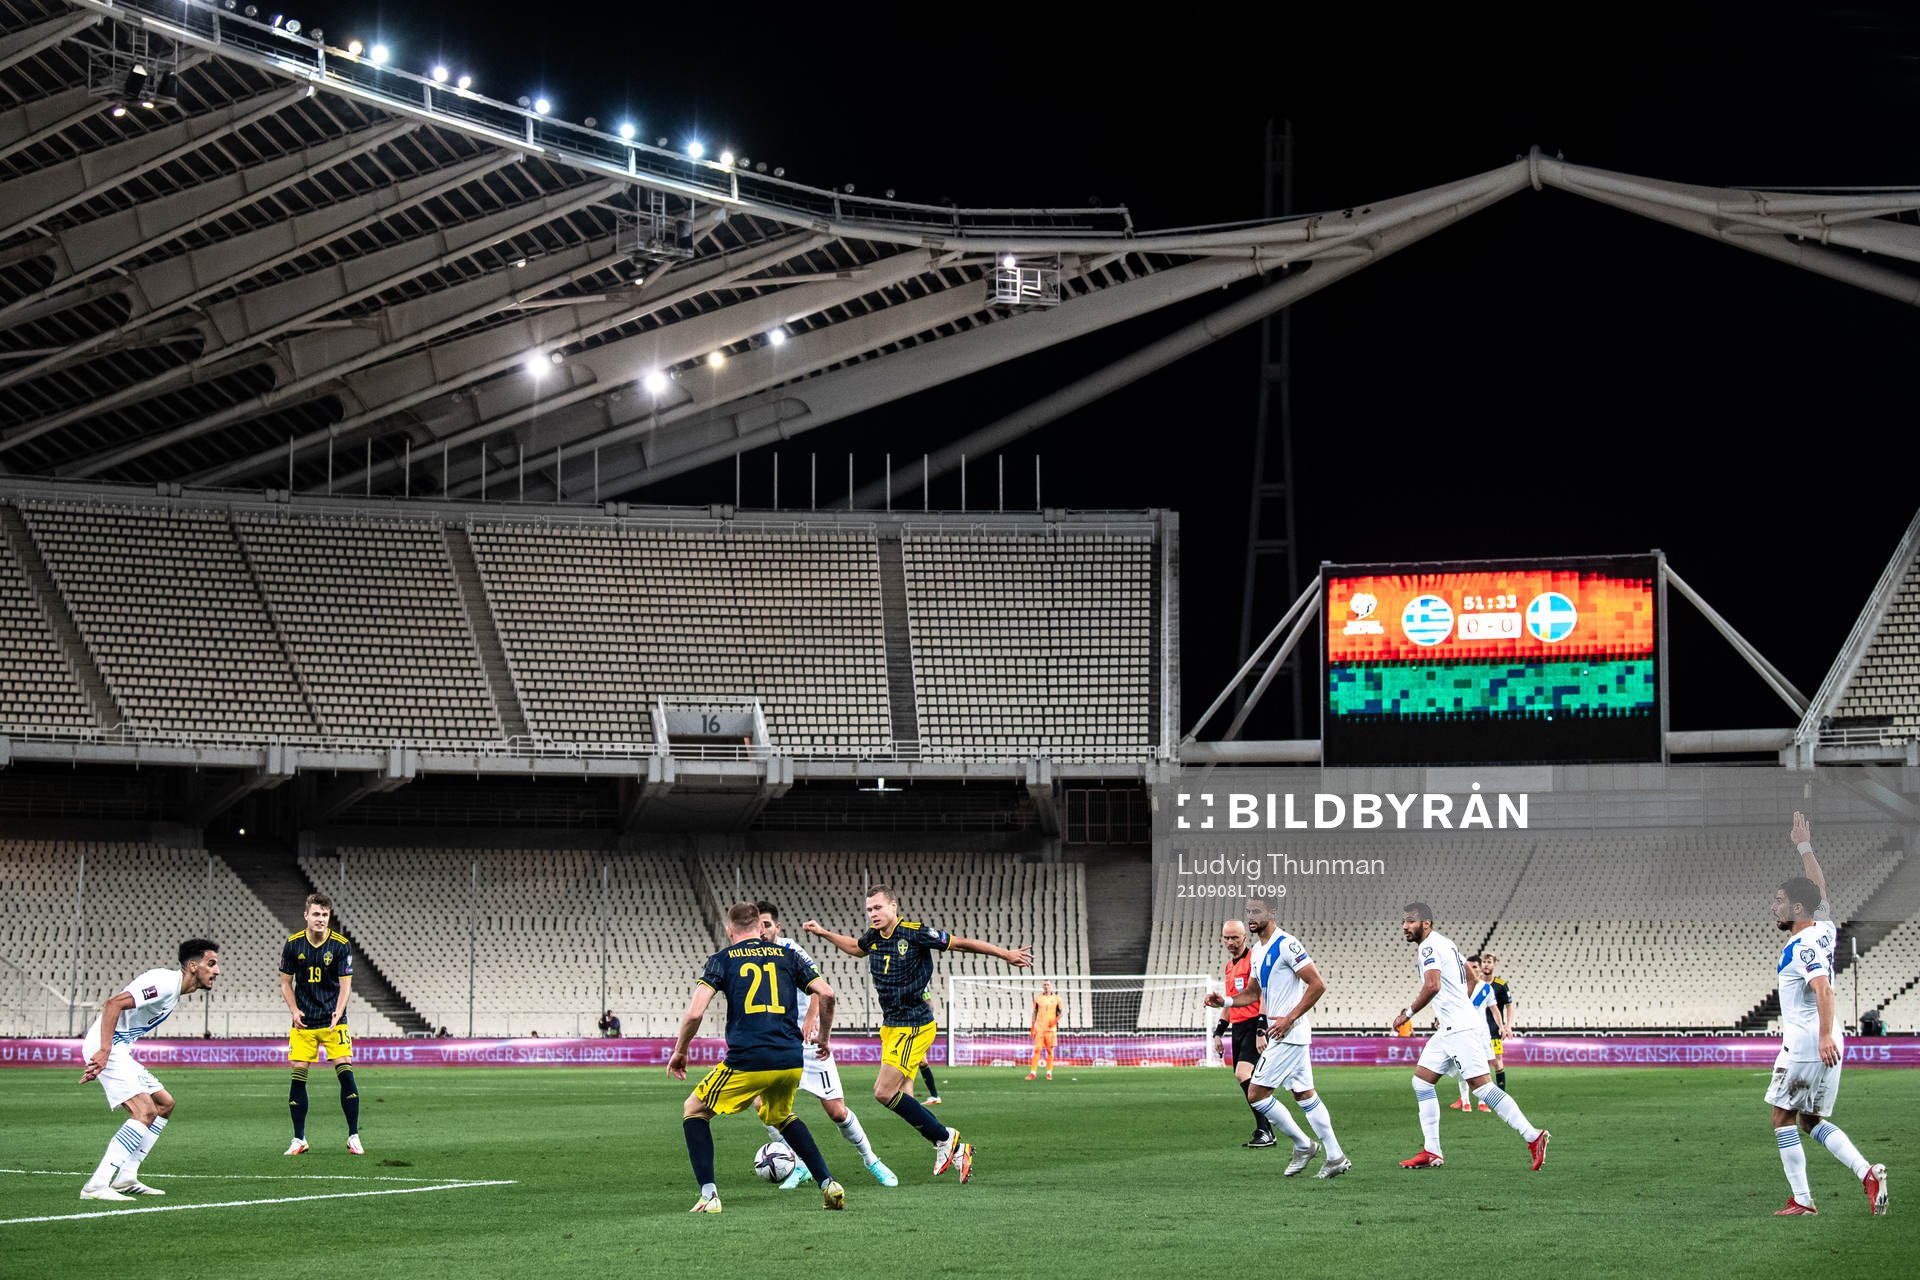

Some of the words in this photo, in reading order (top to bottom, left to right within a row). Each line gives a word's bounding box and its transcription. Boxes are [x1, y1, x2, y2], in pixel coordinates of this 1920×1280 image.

[701, 714, 721, 733] 16
[728, 947, 785, 958] KULUSEVSKI
[883, 954, 891, 974] 7
[308, 966, 322, 983] 19
[739, 962, 786, 1015] 21
[894, 1032, 907, 1048] 7
[182, 1046, 239, 1062] SVENSK
[458, 1047, 514, 1061] BYGGER
[518, 1047, 574, 1062] SVENSK
[580, 1047, 633, 1061] IDROTT
[1543, 1047, 1609, 1062] BYGGER
[1615, 1046, 1680, 1062] SVENSK
[1685, 1046, 1746, 1062] IDROTT
[820, 1070, 831, 1089] 11
